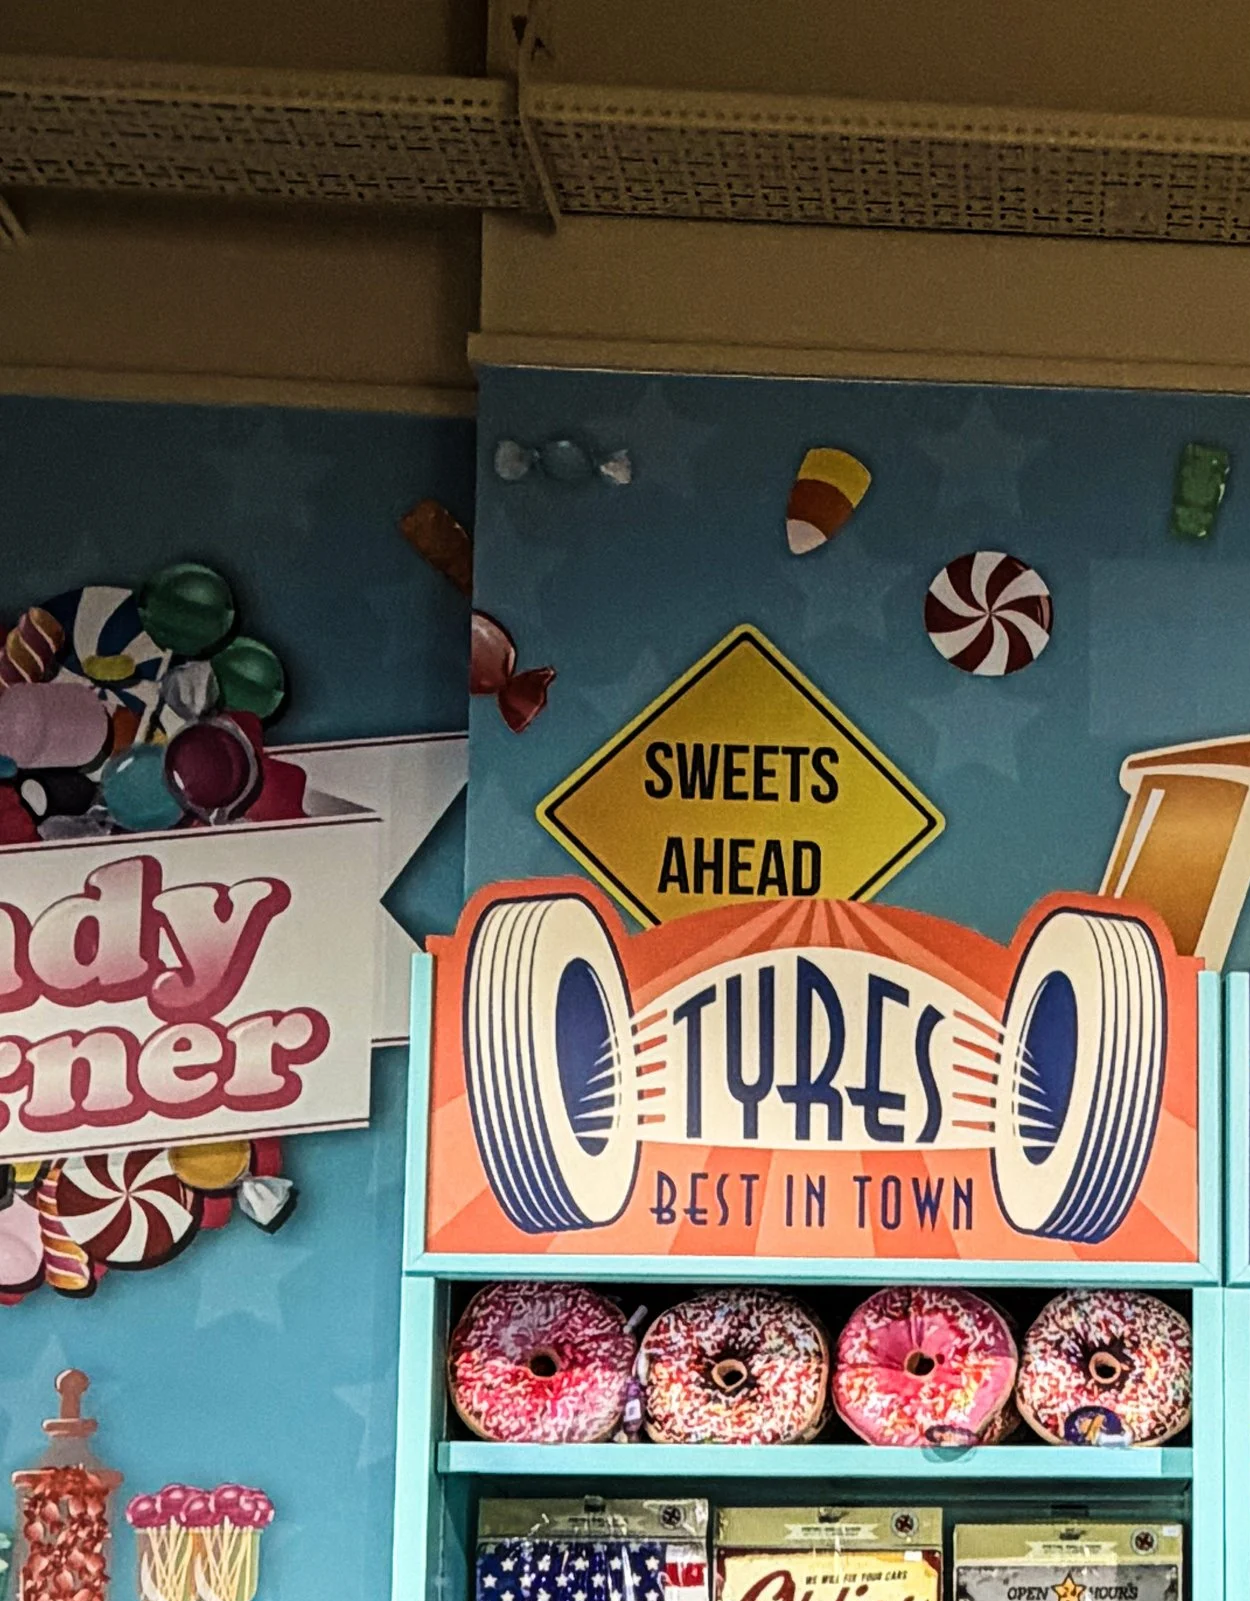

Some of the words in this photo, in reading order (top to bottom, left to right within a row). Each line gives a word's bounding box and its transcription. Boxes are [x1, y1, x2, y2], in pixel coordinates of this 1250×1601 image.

[644, 742, 840, 804] SWEETS
[657, 837, 822, 898] AHEAD
[673, 954, 946, 1144] TYRES
[650, 1170, 760, 1227] BEST
[785, 1174, 827, 1228] IN
[853, 1175, 974, 1232] TOWN
[885, 1570, 908, 1581] CARS
[1007, 1586, 1049, 1601] OPEN
